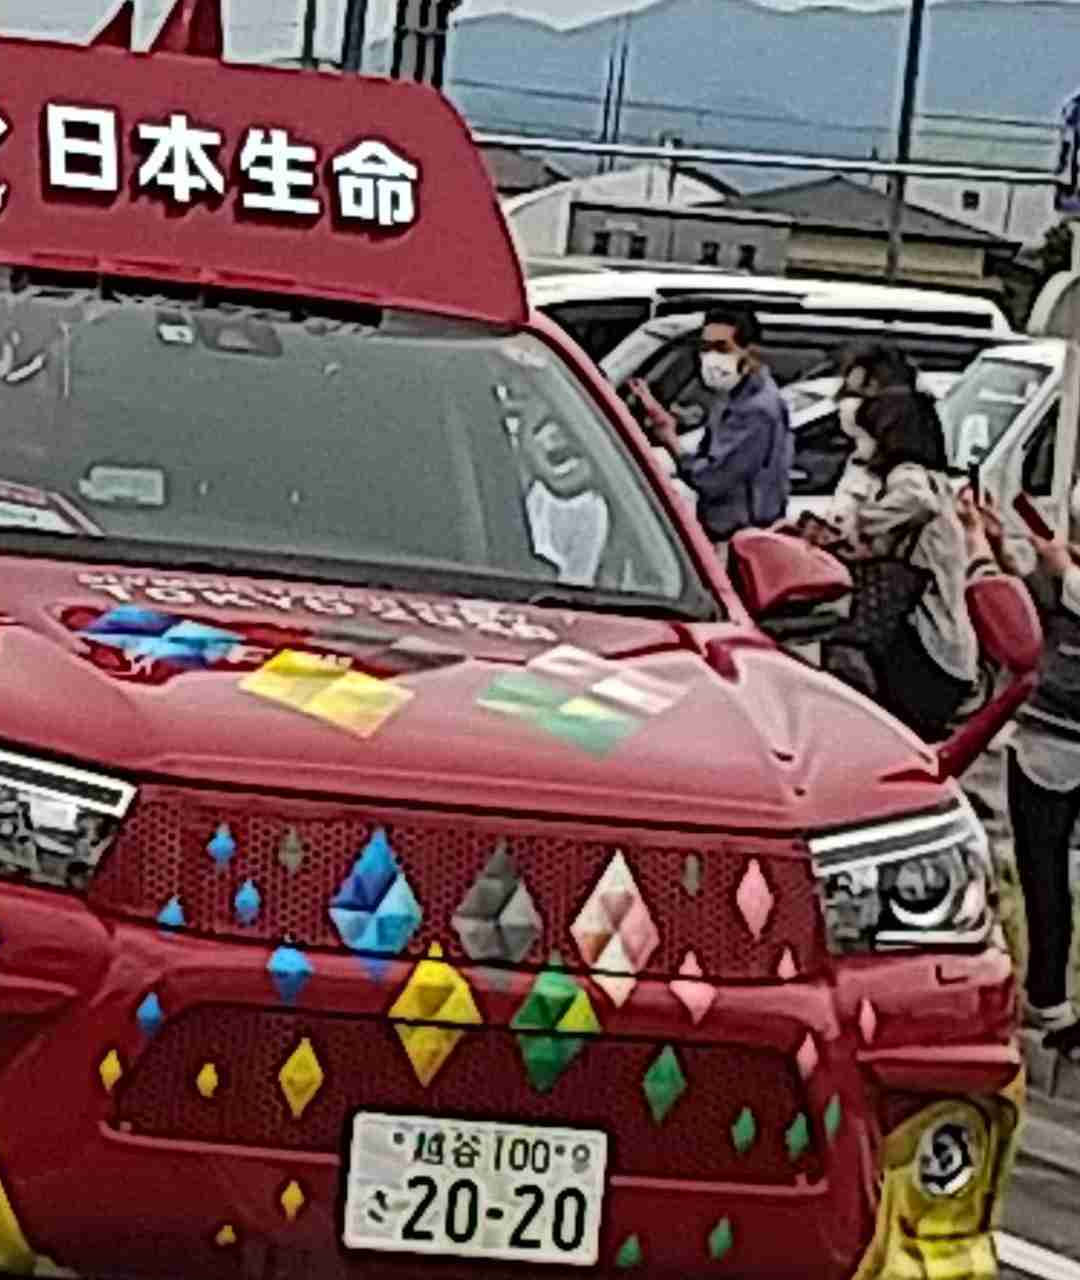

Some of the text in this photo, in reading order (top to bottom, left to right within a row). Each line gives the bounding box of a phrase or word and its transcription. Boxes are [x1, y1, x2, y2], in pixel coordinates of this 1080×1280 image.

[46, 102, 418, 225] 日本生命
[493, 1135, 550, 1173] 100
[401, 1175, 588, 1251] 20-20
